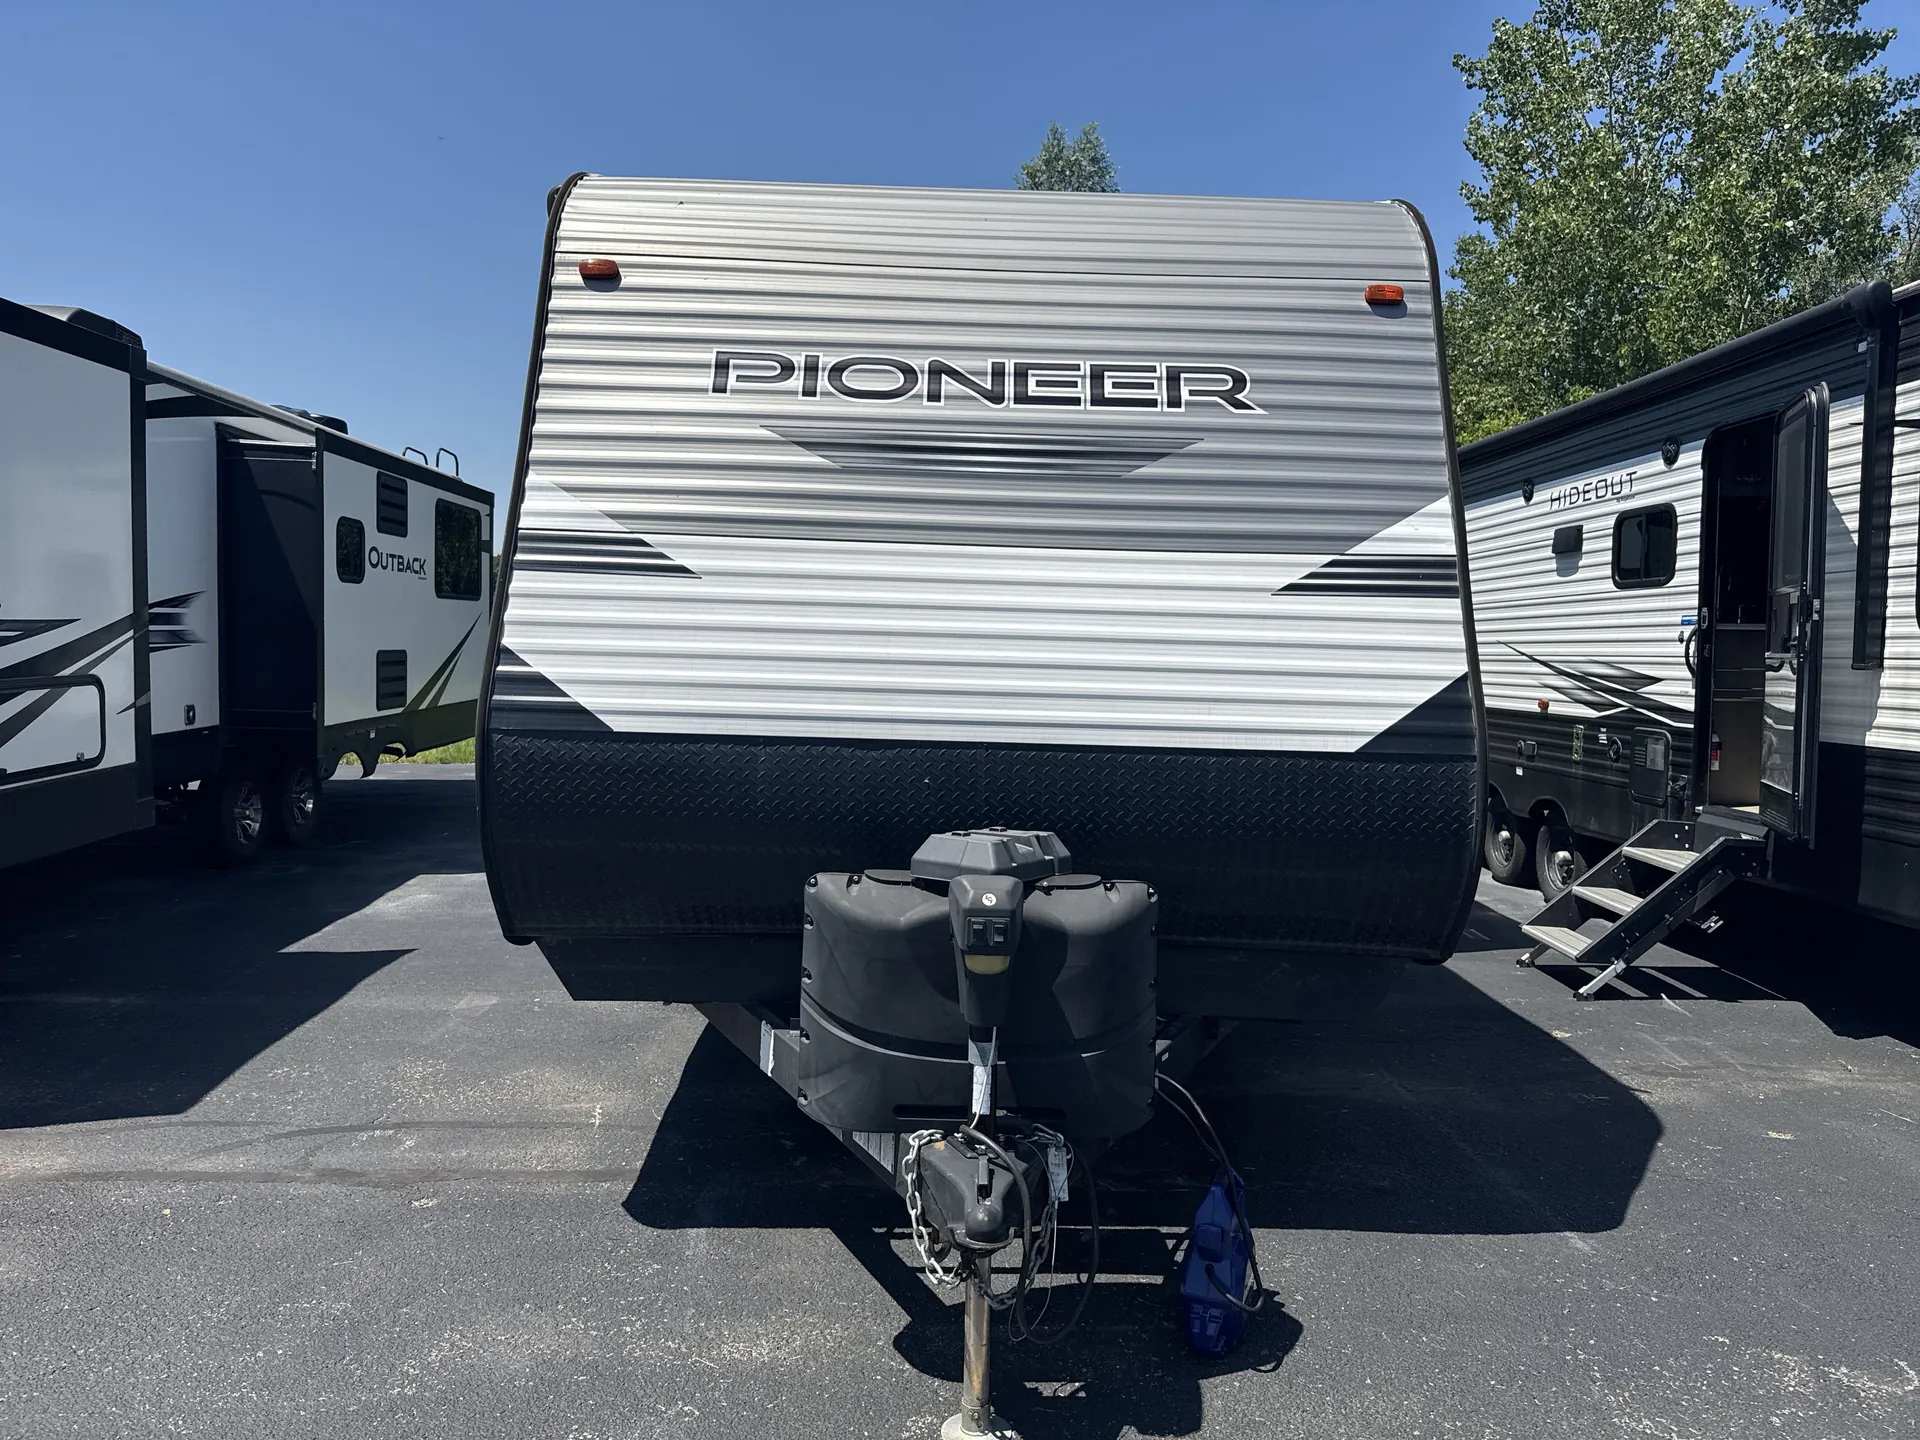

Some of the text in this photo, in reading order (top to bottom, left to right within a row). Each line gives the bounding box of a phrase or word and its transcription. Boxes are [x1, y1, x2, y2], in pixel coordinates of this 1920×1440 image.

[709, 348, 1268, 415] PIONEER
[1550, 471, 1637, 510] HIDEOUT
[368, 546, 426, 575] OUTBACK
